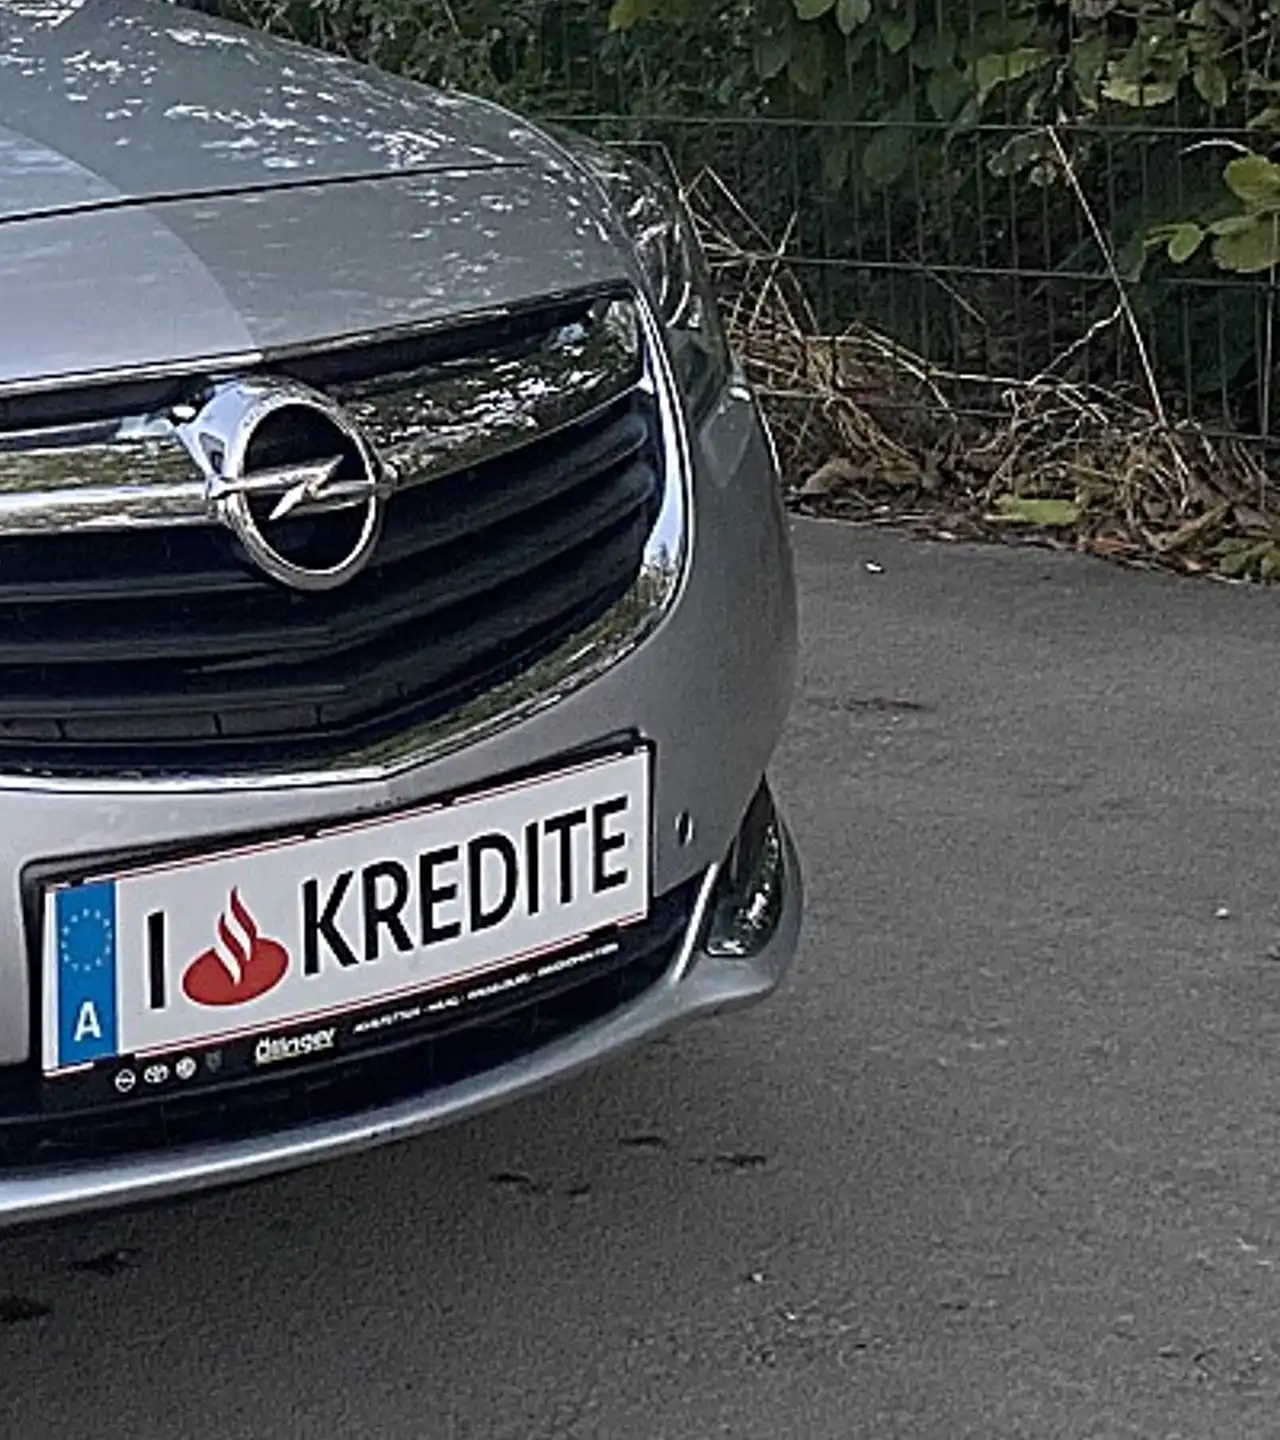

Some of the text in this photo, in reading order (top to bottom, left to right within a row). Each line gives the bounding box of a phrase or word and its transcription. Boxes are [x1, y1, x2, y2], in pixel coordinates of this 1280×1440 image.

[147, 794, 629, 1010] I KREDITE
[73, 1000, 103, 1042] A
